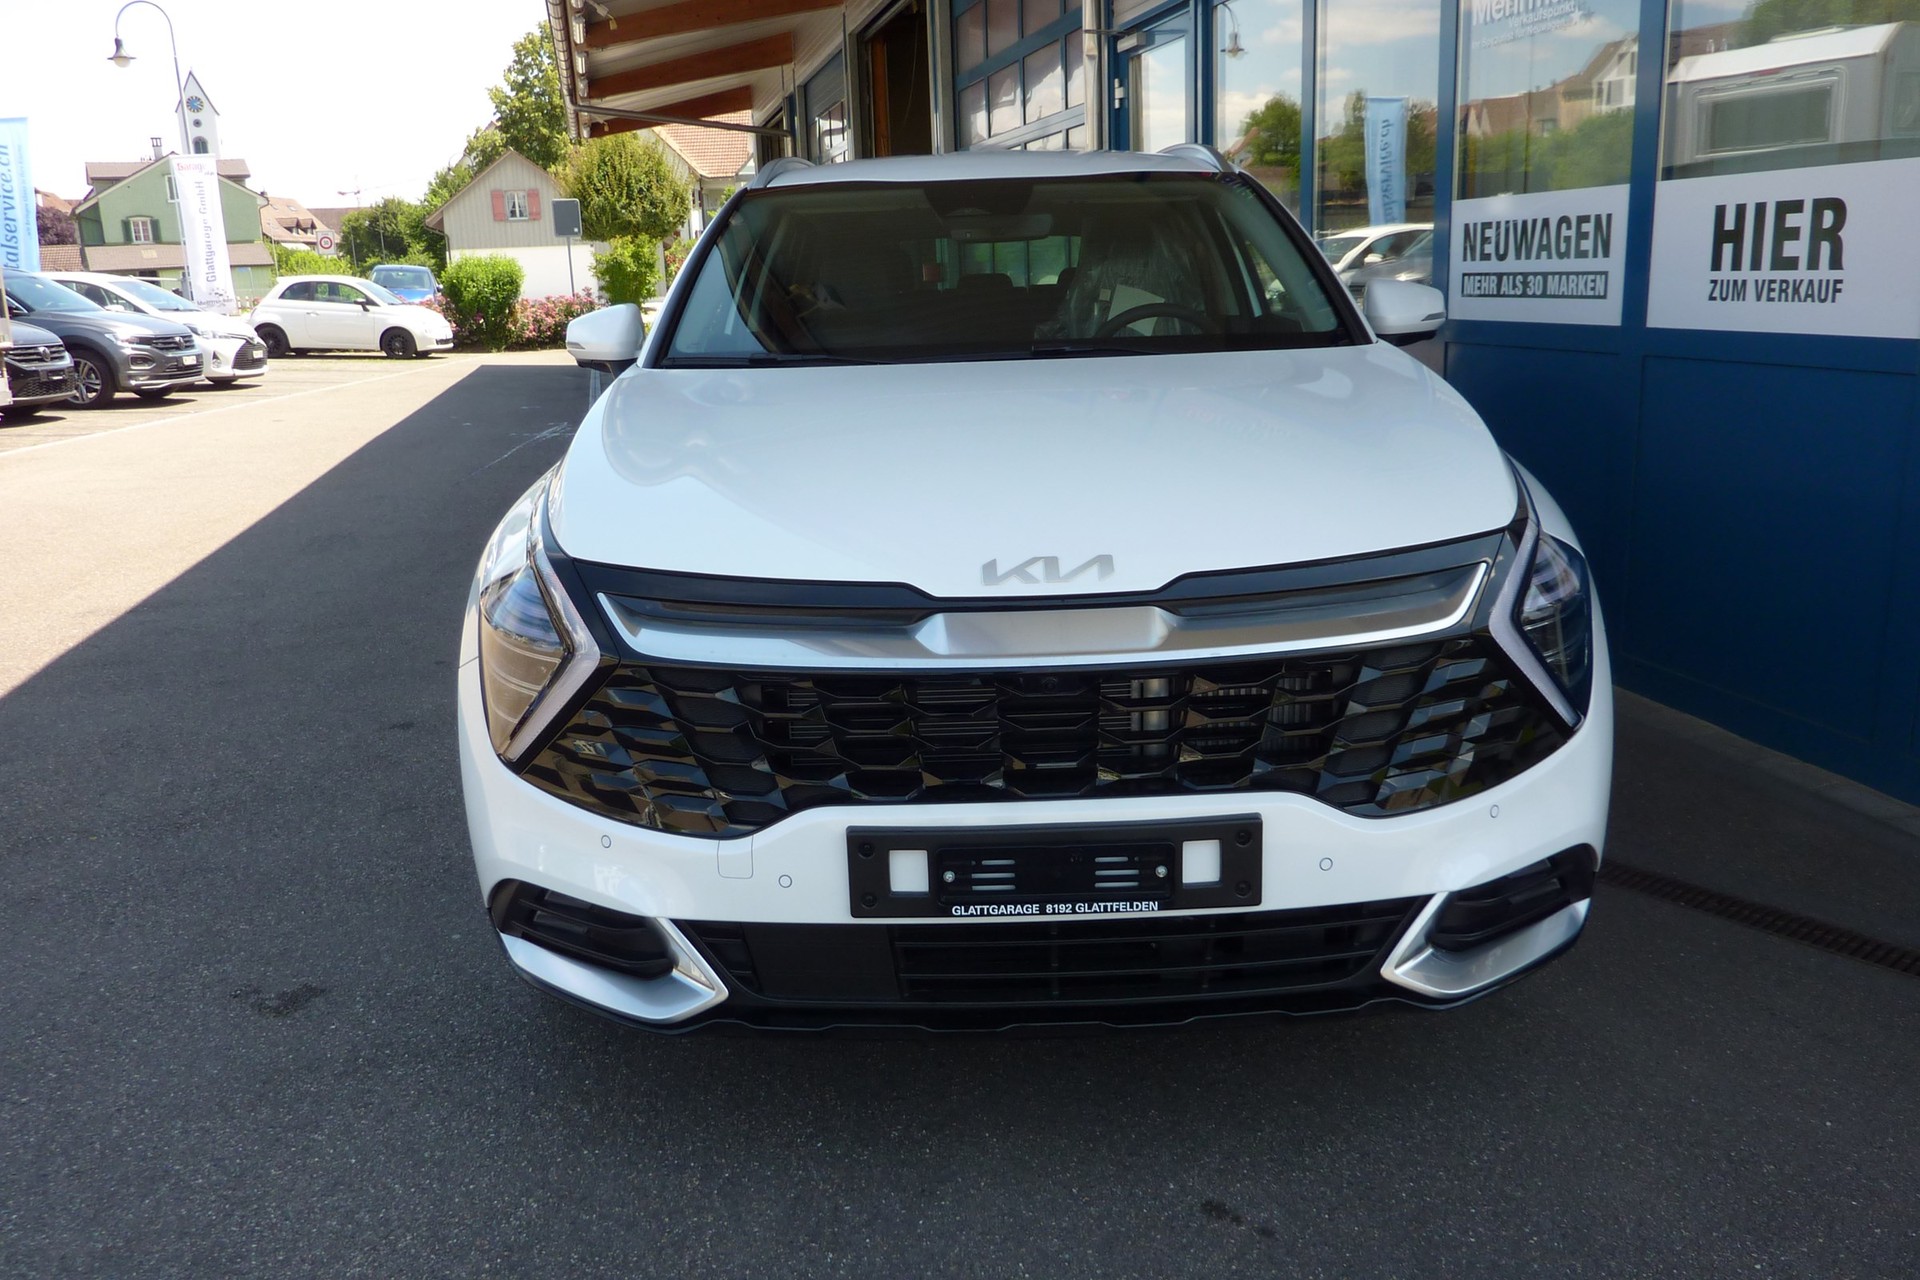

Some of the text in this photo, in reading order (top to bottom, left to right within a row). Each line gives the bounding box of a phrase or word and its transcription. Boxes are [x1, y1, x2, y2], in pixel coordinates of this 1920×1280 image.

[1472, 0, 1561, 26] Mehr
[1508, 1, 1577, 27] Verkaufspunkt
[1462, 213, 1613, 262] NEUWAGEN
[1710, 197, 1848, 272] HIER
[1463, 274, 1606, 296] MEHR ALS 30 MARKEN
[1708, 278, 1844, 304] ZUM VERKAUF
[981, 554, 1115, 586] KIA
[952, 901, 1159, 916] GLATTGARAGE 8192 GLATTFELDEN
